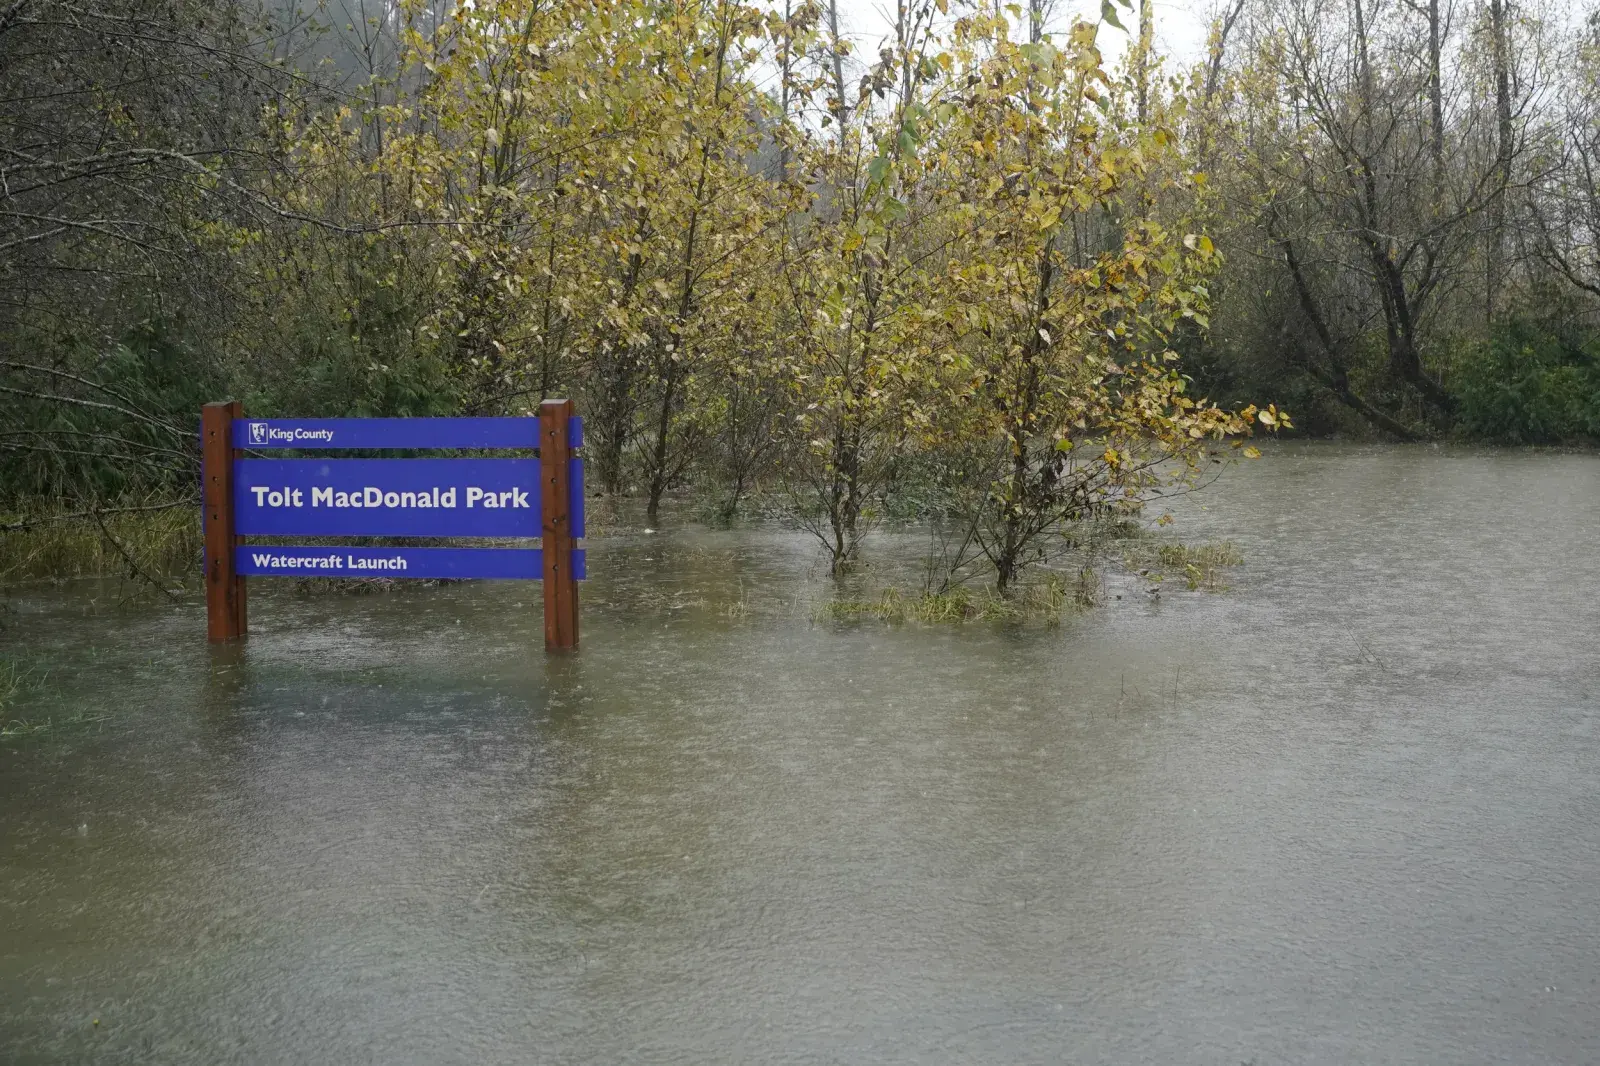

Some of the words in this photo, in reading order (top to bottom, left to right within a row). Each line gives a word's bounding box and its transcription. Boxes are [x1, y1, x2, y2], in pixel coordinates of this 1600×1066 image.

[269, 428, 293, 442] King
[294, 428, 334, 442] County
[250, 486, 304, 508] Tolt
[311, 486, 457, 509] MacDonald
[466, 487, 531, 509] Park
[252, 553, 343, 569] Watercraft
[347, 554, 408, 570] Launch
